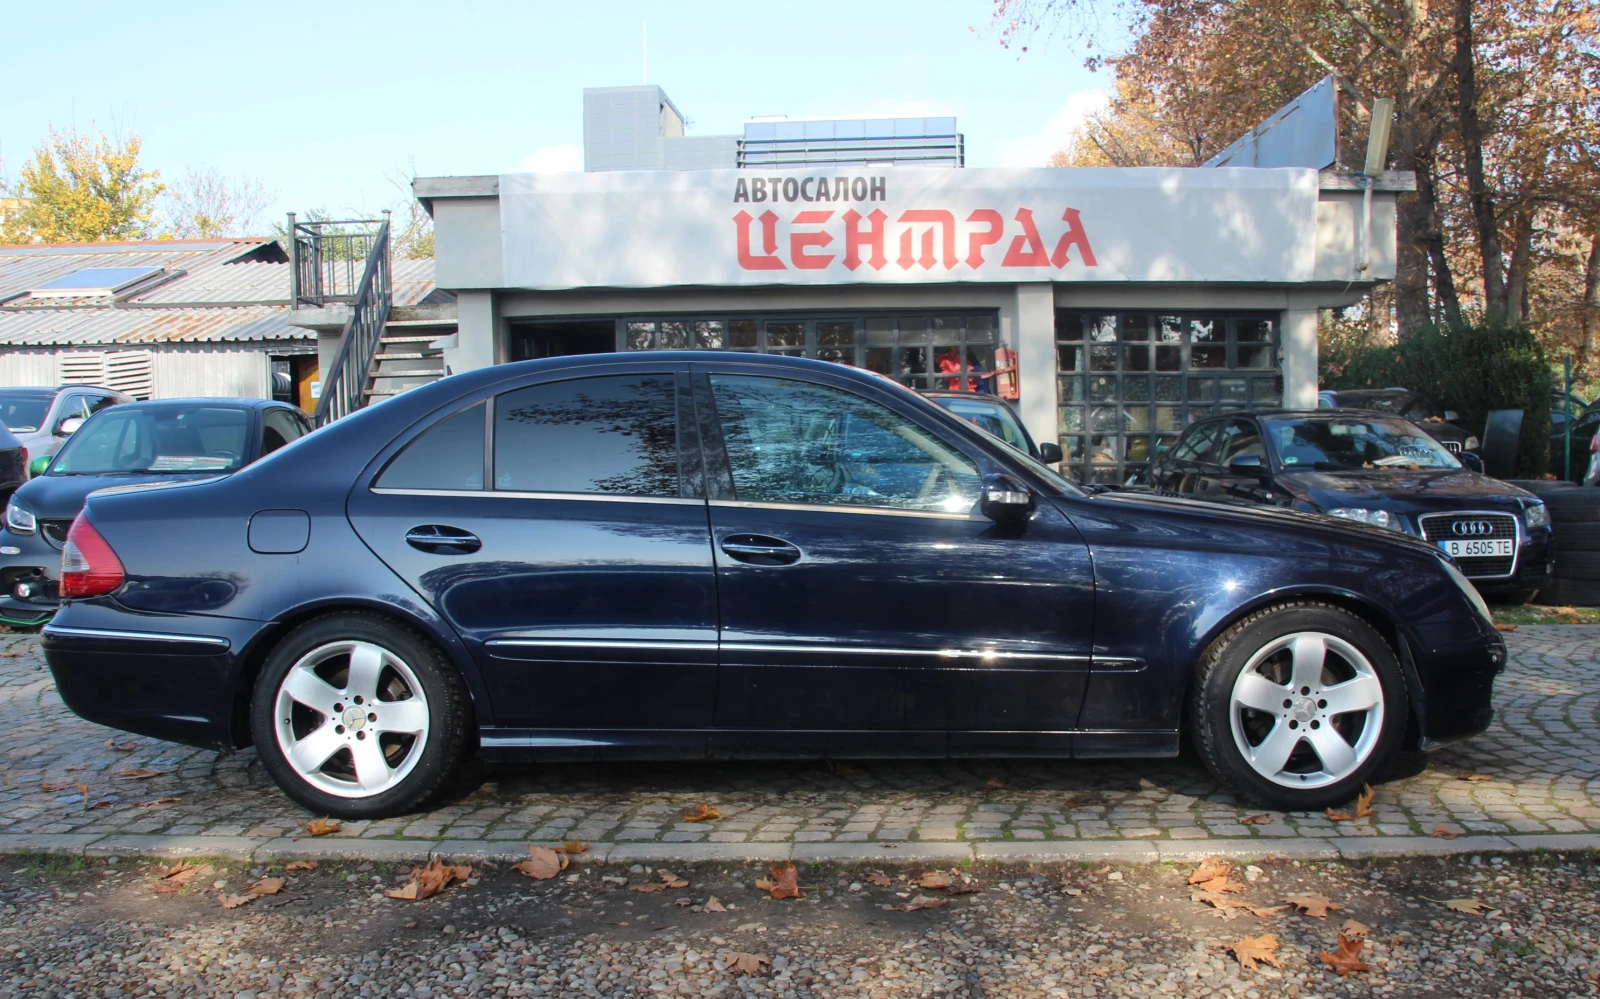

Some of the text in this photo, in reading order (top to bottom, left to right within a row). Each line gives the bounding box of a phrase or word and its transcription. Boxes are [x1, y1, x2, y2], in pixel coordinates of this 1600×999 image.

[734, 177, 886, 203] АВТОСАЛОН
[732, 207, 1098, 272] ЦЕНТРАЛ
[1451, 541, 1511, 555] B 6505 TE
